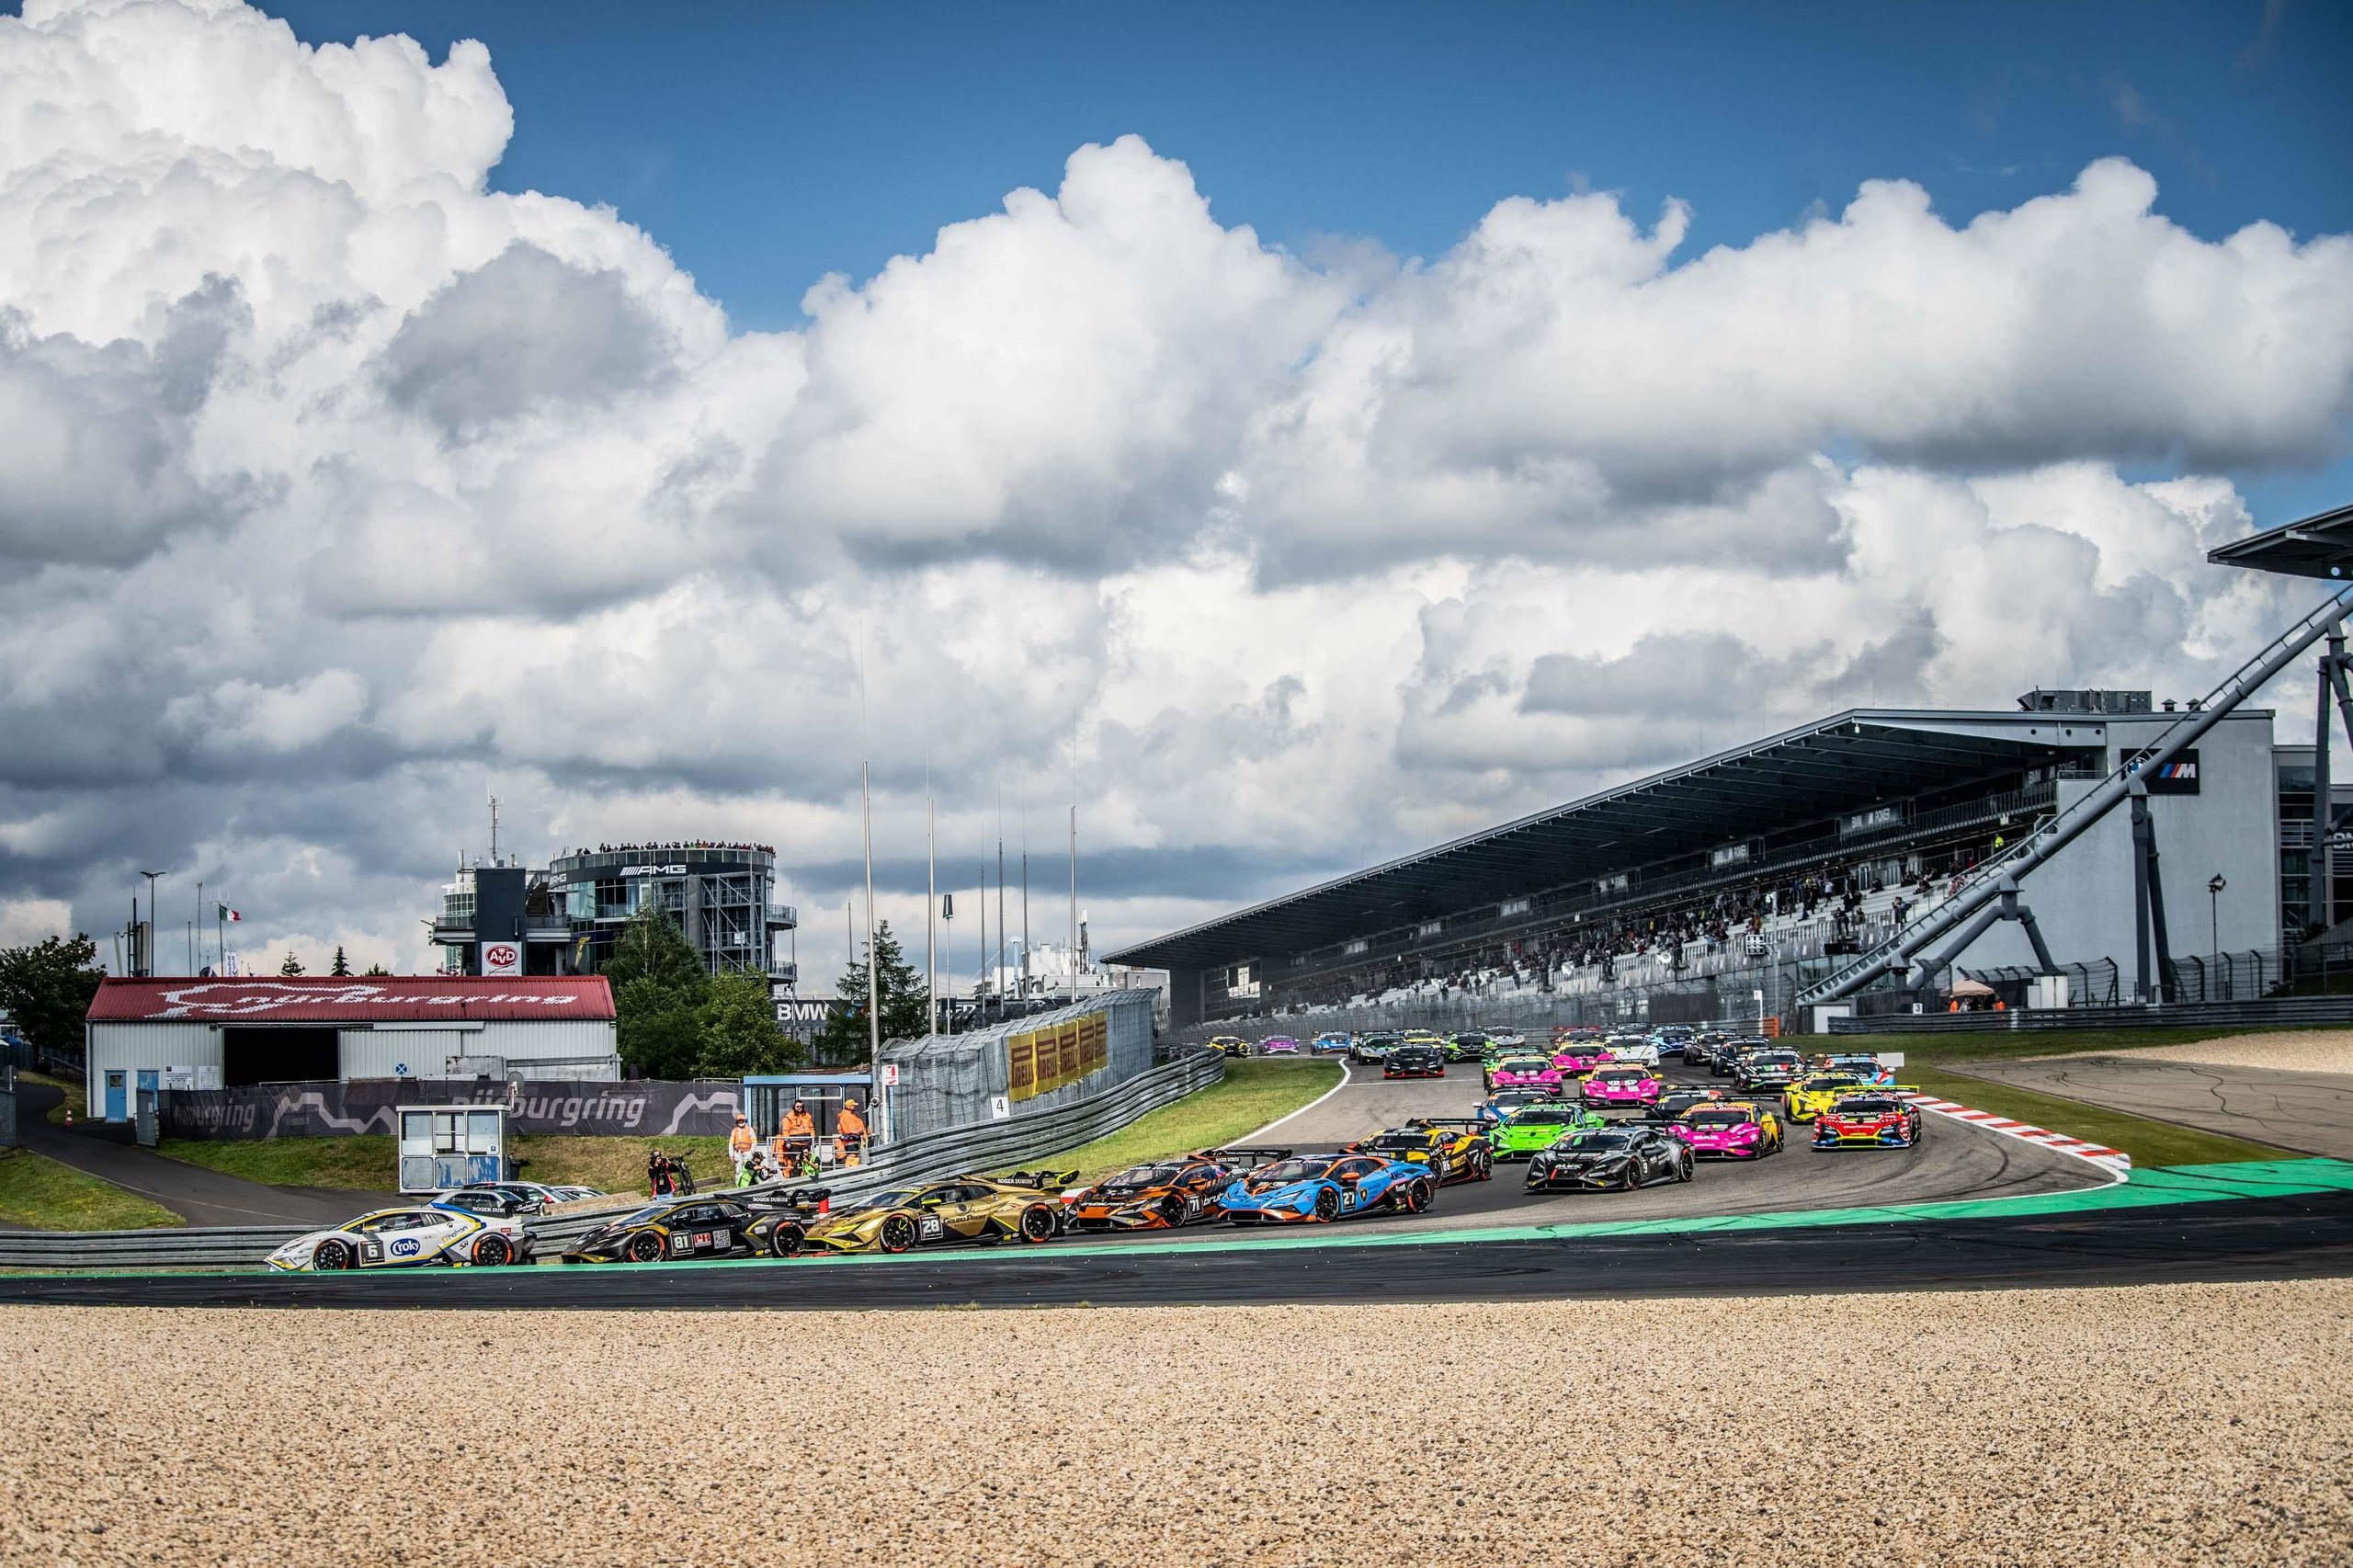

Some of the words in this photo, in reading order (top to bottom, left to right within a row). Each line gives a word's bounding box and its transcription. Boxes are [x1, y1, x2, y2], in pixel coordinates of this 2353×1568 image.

[637, 865, 687, 875] AMG
[777, 1003, 830, 1021] BMW
[1915, 1004, 1921, 1012] 3
[1011, 1044, 1034, 1089] PIRELLI
[1036, 1039, 1057, 1081] PIRELLI
[996, 1099, 1005, 1112] 4
[1343, 1192, 1355, 1205] 27
[1189, 1199, 1199, 1212] 71
[922, 1220, 939, 1233] 28
[392, 1240, 419, 1255] Croky
[674, 1236, 688, 1249] 81
[367, 1245, 378, 1258] 6
